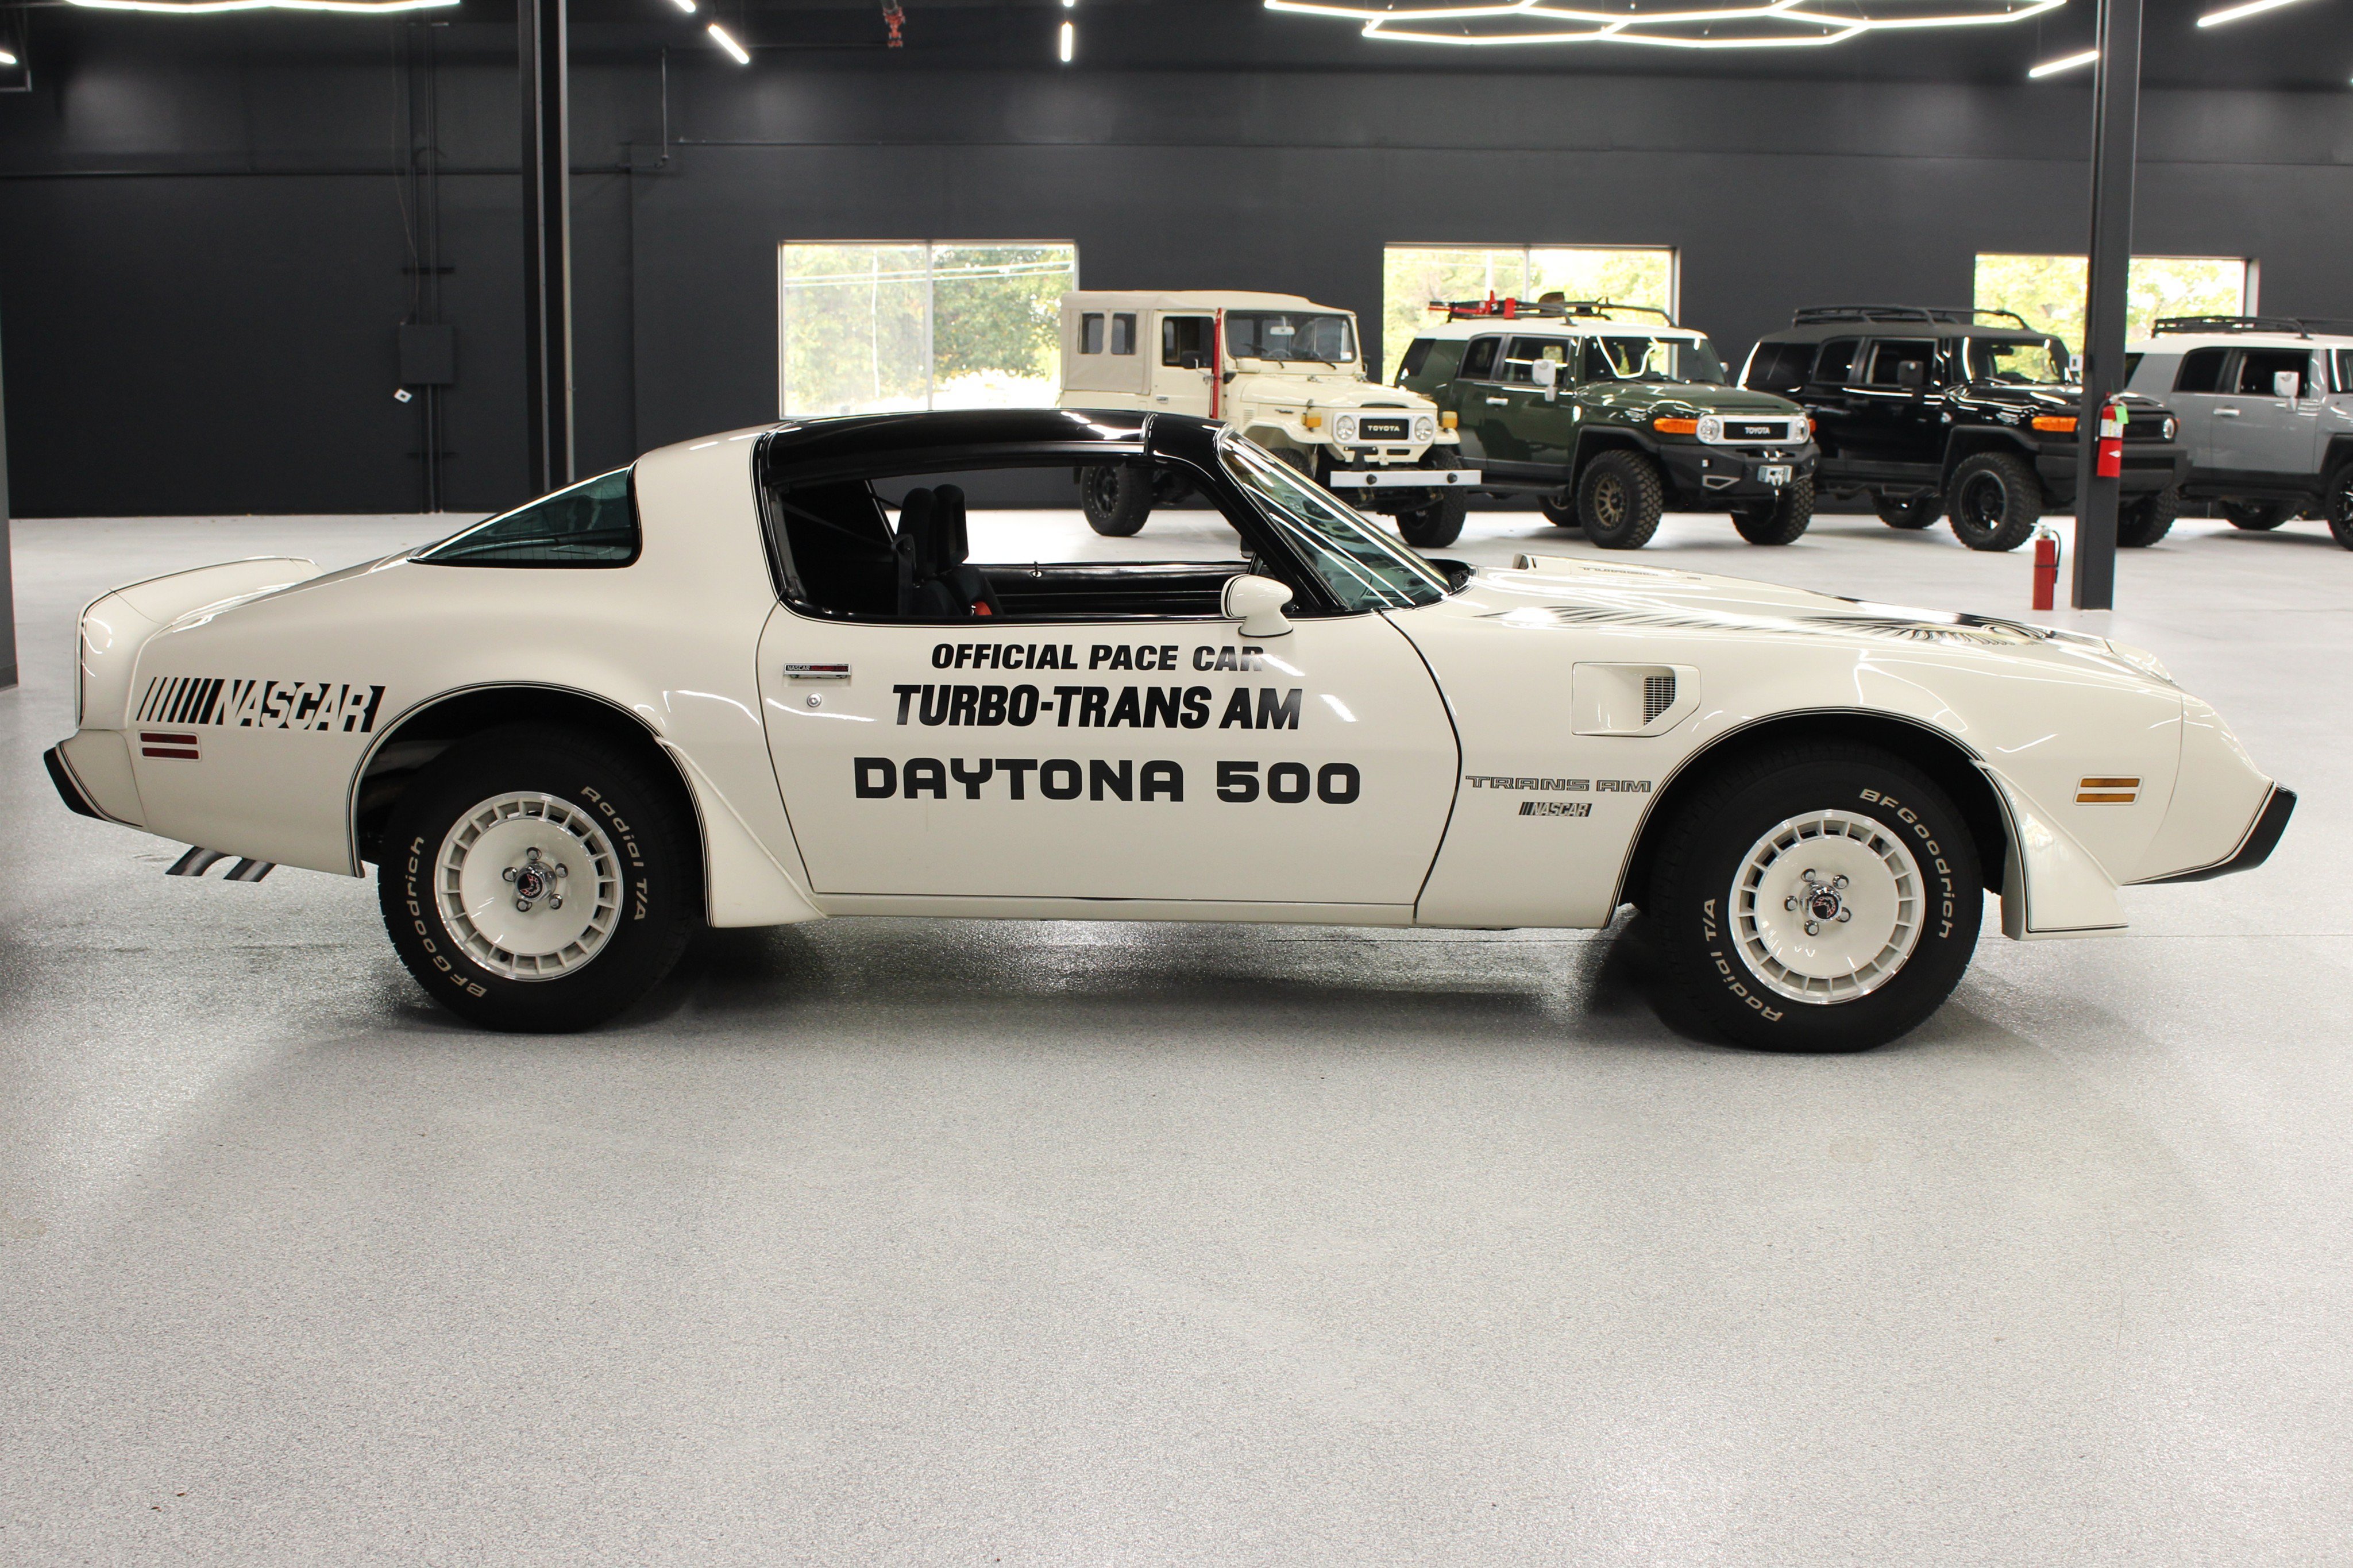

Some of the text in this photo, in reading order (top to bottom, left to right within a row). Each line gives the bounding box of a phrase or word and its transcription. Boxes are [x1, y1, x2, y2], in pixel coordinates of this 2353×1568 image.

[1745, 427, 1770, 435] TOYOTA
[931, 643, 1264, 671] OFFICIAL PACE CAR
[211, 678, 386, 733] NASCAR
[892, 684, 1303, 730] TURBO-TRANS AM
[854, 757, 1360, 805] DAYTONA 500
[1465, 775, 1652, 793] TRANS AM
[1526, 802, 1591, 817] NASCAR
[581, 786, 648, 920] Radial T/A
[1859, 788, 1955, 939] BFGoodrich
[405, 836, 487, 998] BFGoodrich
[1703, 898, 1783, 1022] Radial T/A
